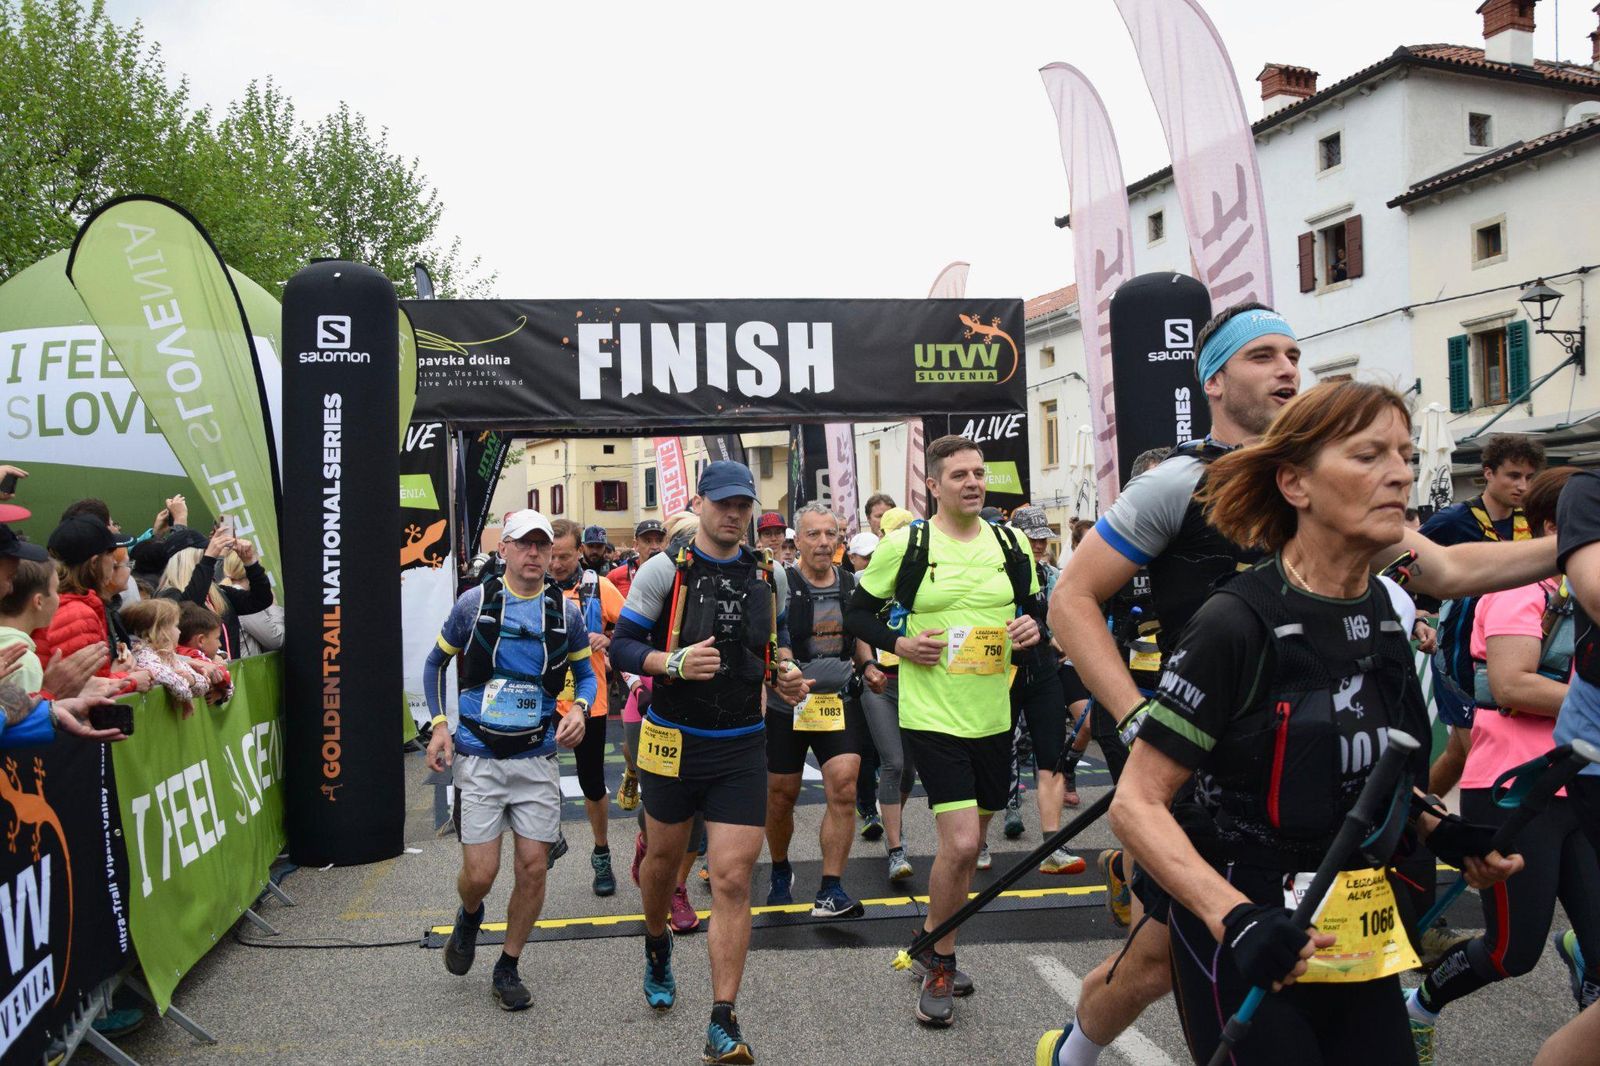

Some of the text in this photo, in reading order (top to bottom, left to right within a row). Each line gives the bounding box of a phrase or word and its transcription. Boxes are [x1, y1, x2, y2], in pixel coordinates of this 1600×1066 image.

[38, 338, 131, 382] FEE
[299, 351, 371, 364] salomon
[418, 355, 511, 368] pavska dolina
[577, 320, 835, 400] FINISH
[1148, 350, 1194, 362] salom
[917, 371, 996, 382] SLOVENIA
[400, 488, 426, 499] ENIA
[983, 644, 1003, 656] 750
[516, 698, 537, 710] 396
[819, 707, 841, 717] 1083
[647, 742, 678, 759] 1192
[100, 787, 111, 828] Valley
[155, 758, 227, 882] FEEL
[1359, 905, 1395, 938] 1066
[0, 964, 51, 1040] VENIA
